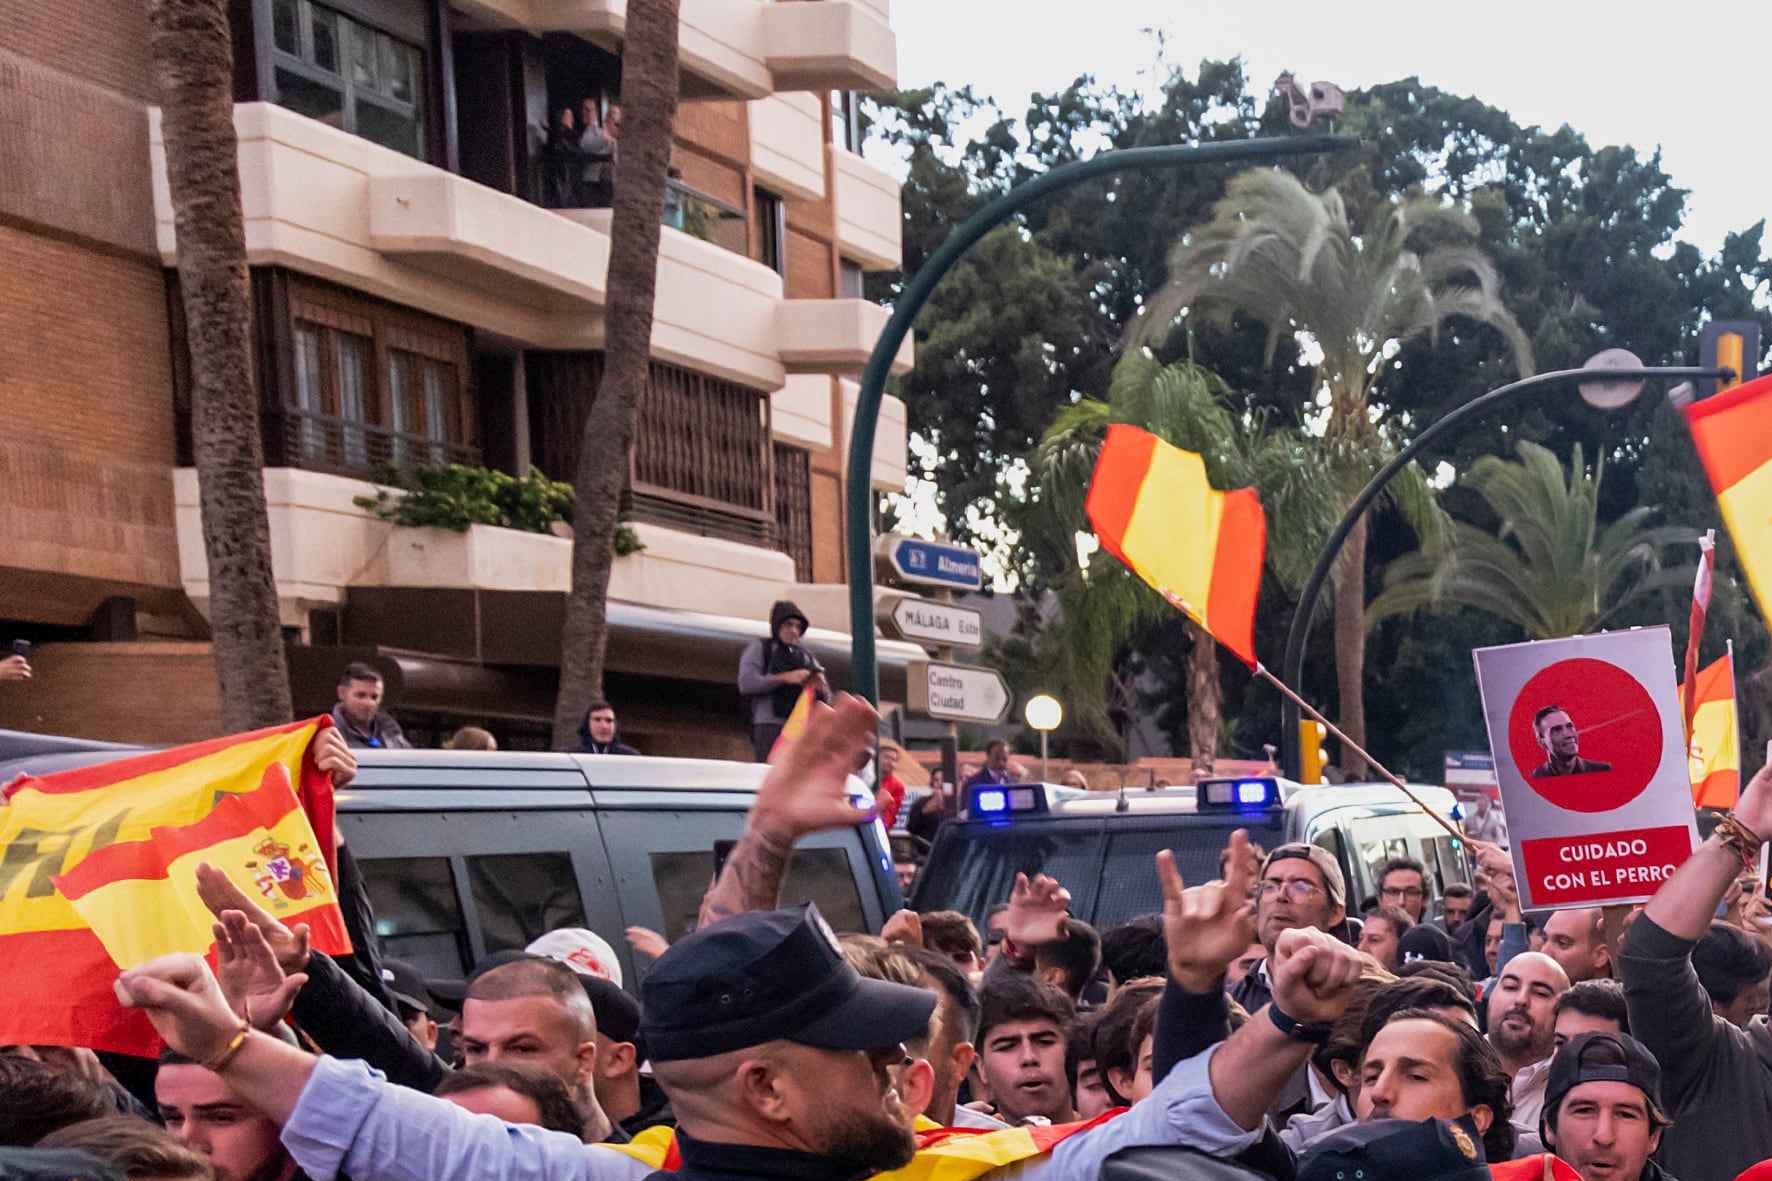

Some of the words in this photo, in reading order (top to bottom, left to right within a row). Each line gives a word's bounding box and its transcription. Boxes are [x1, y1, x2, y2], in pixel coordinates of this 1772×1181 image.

[905, 609, 949, 630] MÁLAGA
[930, 692, 965, 709] Ciudad
[1559, 839, 1647, 862] CUIDADO
[1543, 873, 1586, 890] CON
[1590, 870, 1611, 886] EL
[1615, 864, 1676, 884] PERRO
